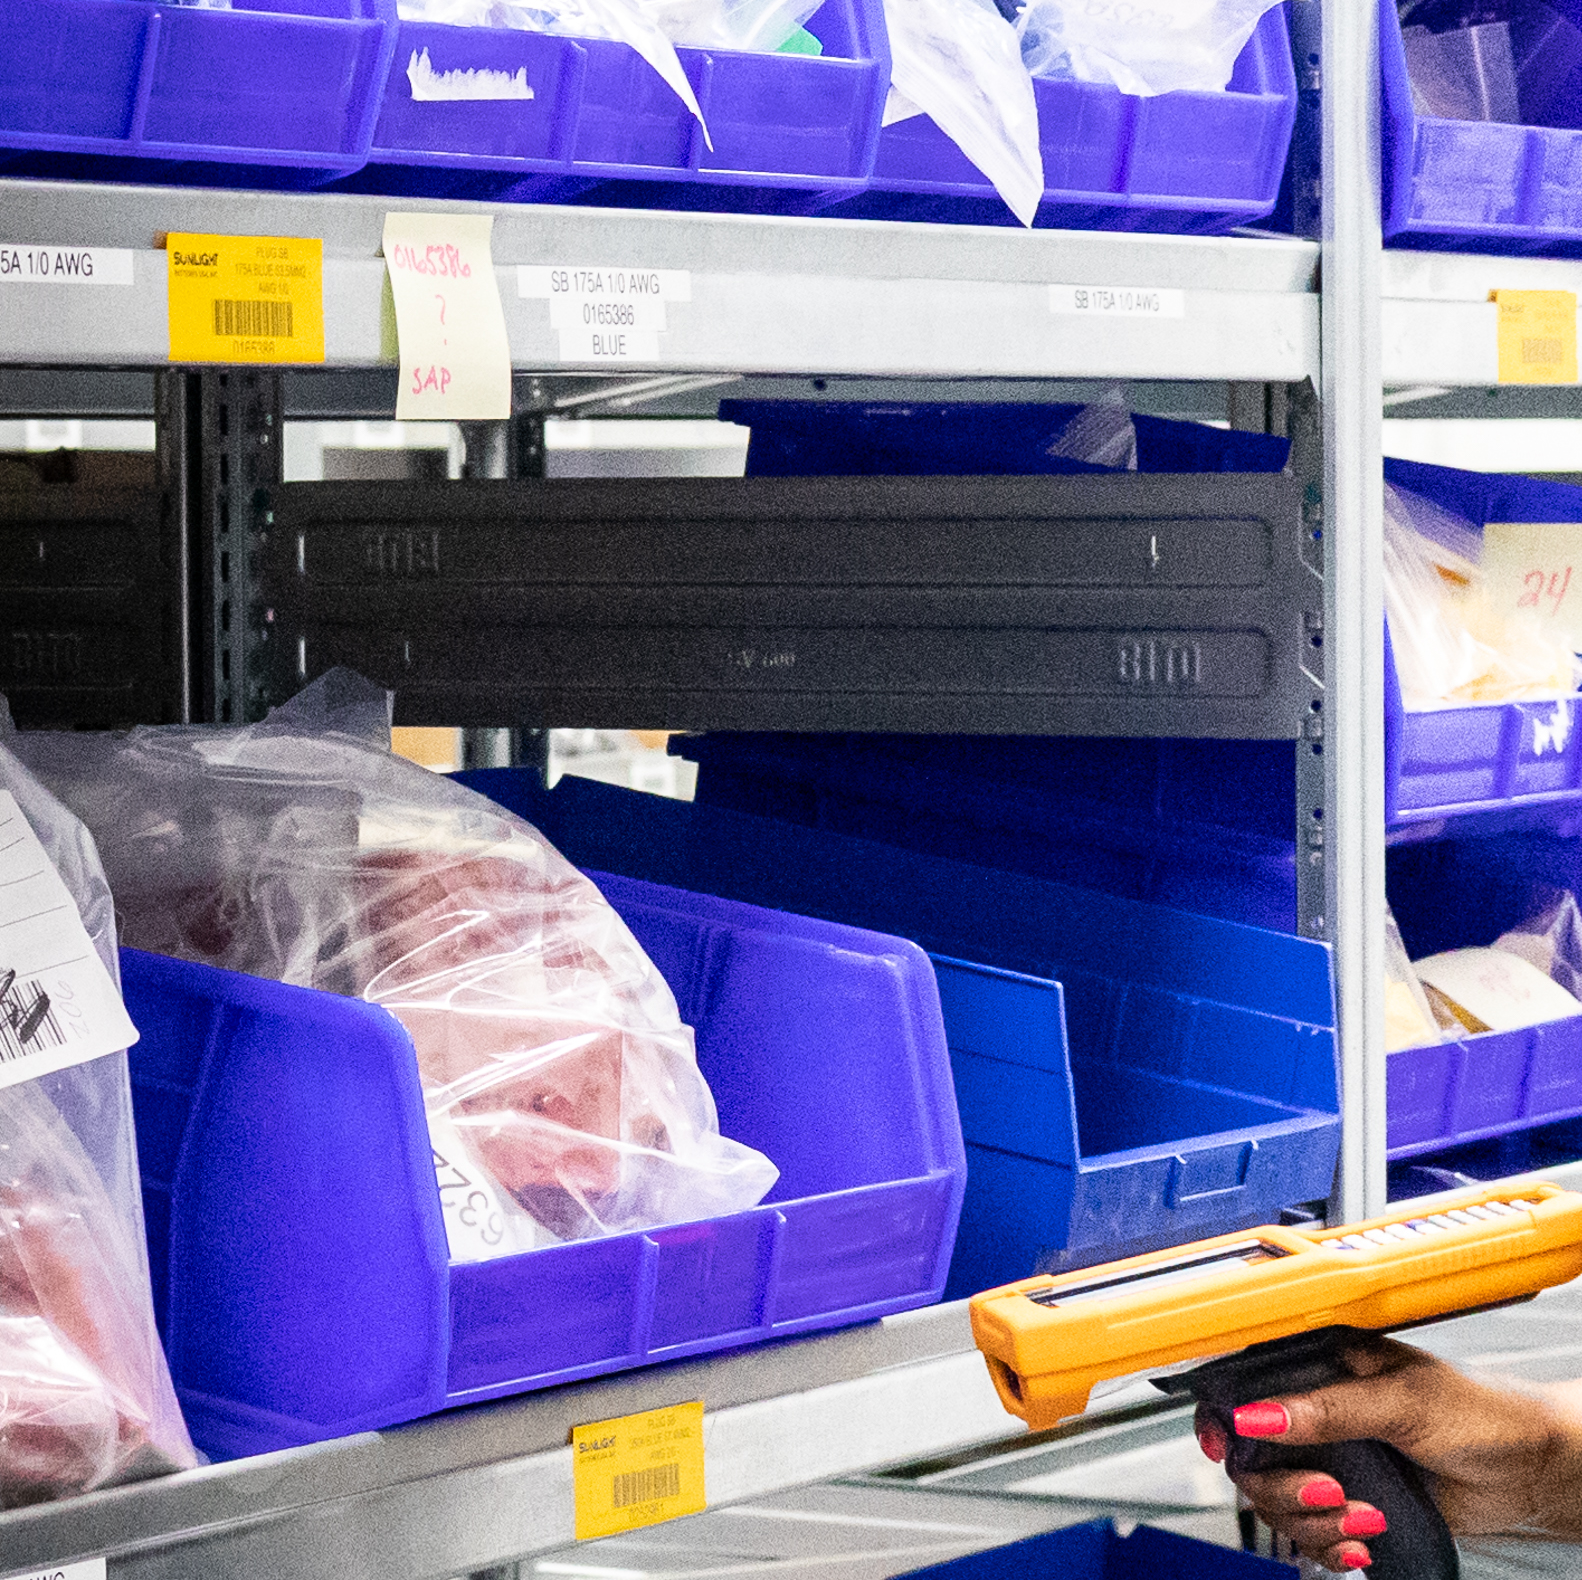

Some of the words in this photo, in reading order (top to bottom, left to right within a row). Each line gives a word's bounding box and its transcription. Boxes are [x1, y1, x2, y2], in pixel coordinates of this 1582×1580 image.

[27, 251, 49, 275] 1/0
[54, 252, 93, 276] AWG
[551, 271, 569, 293] SB
[574, 272, 604, 293] 175A
[608, 273, 626, 294] 1/0
[629, 274, 660, 295] AWG
[1074, 289, 1089, 309] SB
[1092, 291, 1116, 310] 175A
[1135, 293, 1160, 312] AWG
[583, 303, 635, 326] 0165386
[592, 334, 627, 356] BLUE
[412, 365, 452, 395] SAP
[1517, 566, 1572, 617] 24
